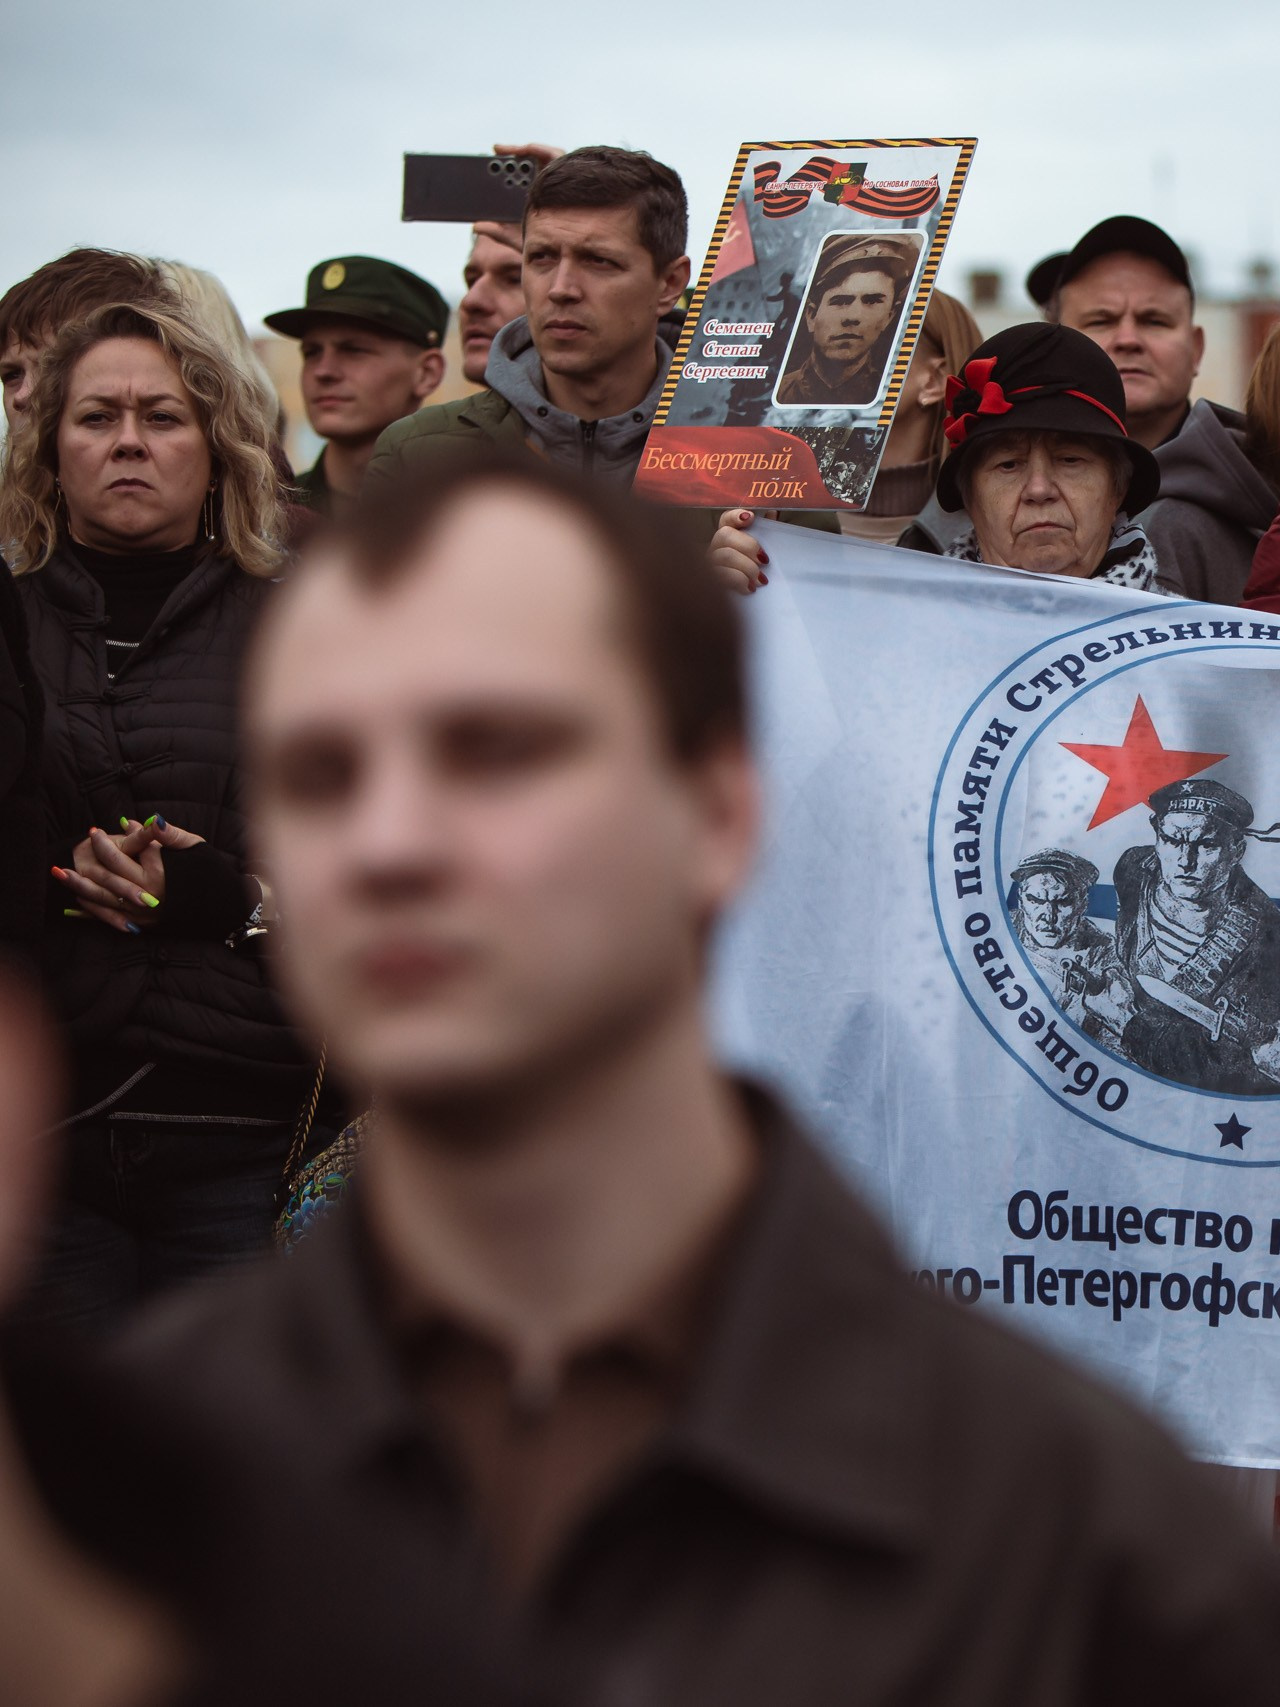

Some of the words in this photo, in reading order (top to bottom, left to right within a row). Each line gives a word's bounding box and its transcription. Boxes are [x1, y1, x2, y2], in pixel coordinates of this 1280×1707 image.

[863, 180, 875, 189] МО
[876, 180, 910, 189] СОСНОВАЯ
[910, 179, 938, 188] ПОЛЯНА
[703, 319, 774, 339] Семенец
[702, 341, 761, 358] Степан
[682, 363, 767, 382] Сергеевич
[643, 446, 793, 477] Бессмертный
[953, 717, 1019, 901] памяти
[963, 910, 1130, 1113] Общество
[1007, 1189, 1253, 1252] Общество
